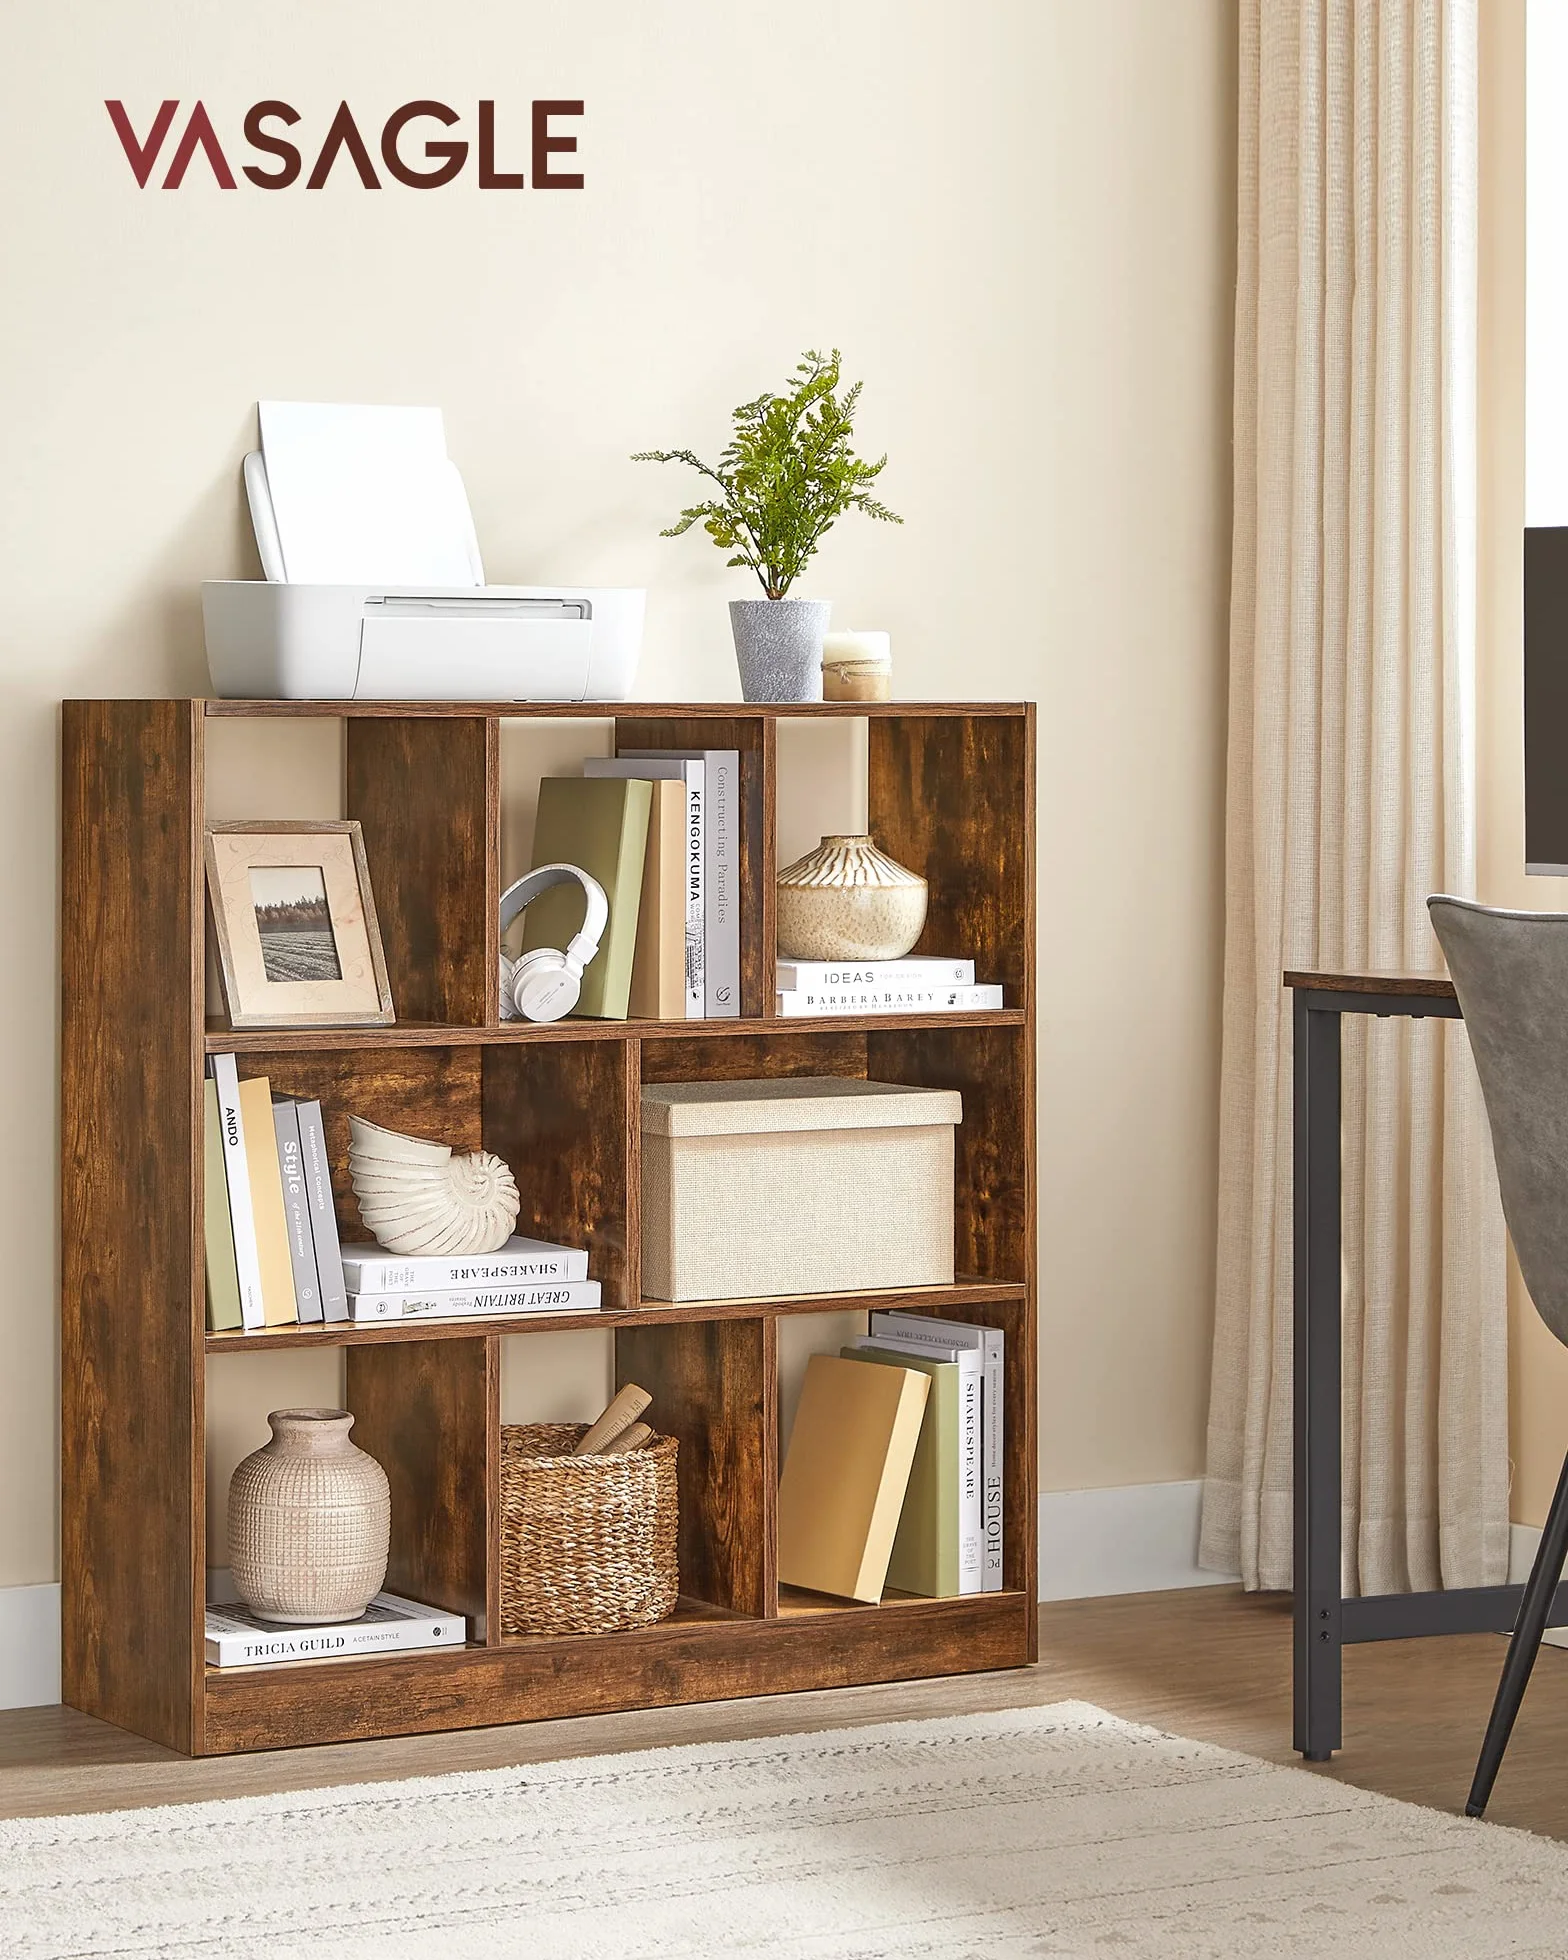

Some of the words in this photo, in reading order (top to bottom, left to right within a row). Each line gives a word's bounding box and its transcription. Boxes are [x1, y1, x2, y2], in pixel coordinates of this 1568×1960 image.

[716, 766, 729, 858] Constructing
[690, 790, 701, 902] KENGOKUMA
[717, 864, 729, 924] Paradies
[807, 995, 878, 1005] BARBERA
[884, 992, 934, 1003] BAREY
[824, 971, 875, 984] IDEAS
[225, 1106, 239, 1147] ANDO
[283, 1140, 301, 1195] Style
[308, 1125, 320, 1174] Metaphorical
[316, 1176, 326, 1210] Concepts
[450, 1263, 558, 1280] SHAKESPEARE
[473, 1291, 526, 1308] BRITAIN
[529, 1290, 570, 1305] GREAT
[965, 1382, 974, 1500] SHAKESPEARE
[987, 1476, 1001, 1553] HOUSE
[244, 1642, 296, 1657] TRICIA
[300, 1637, 345, 1652] GUILD
